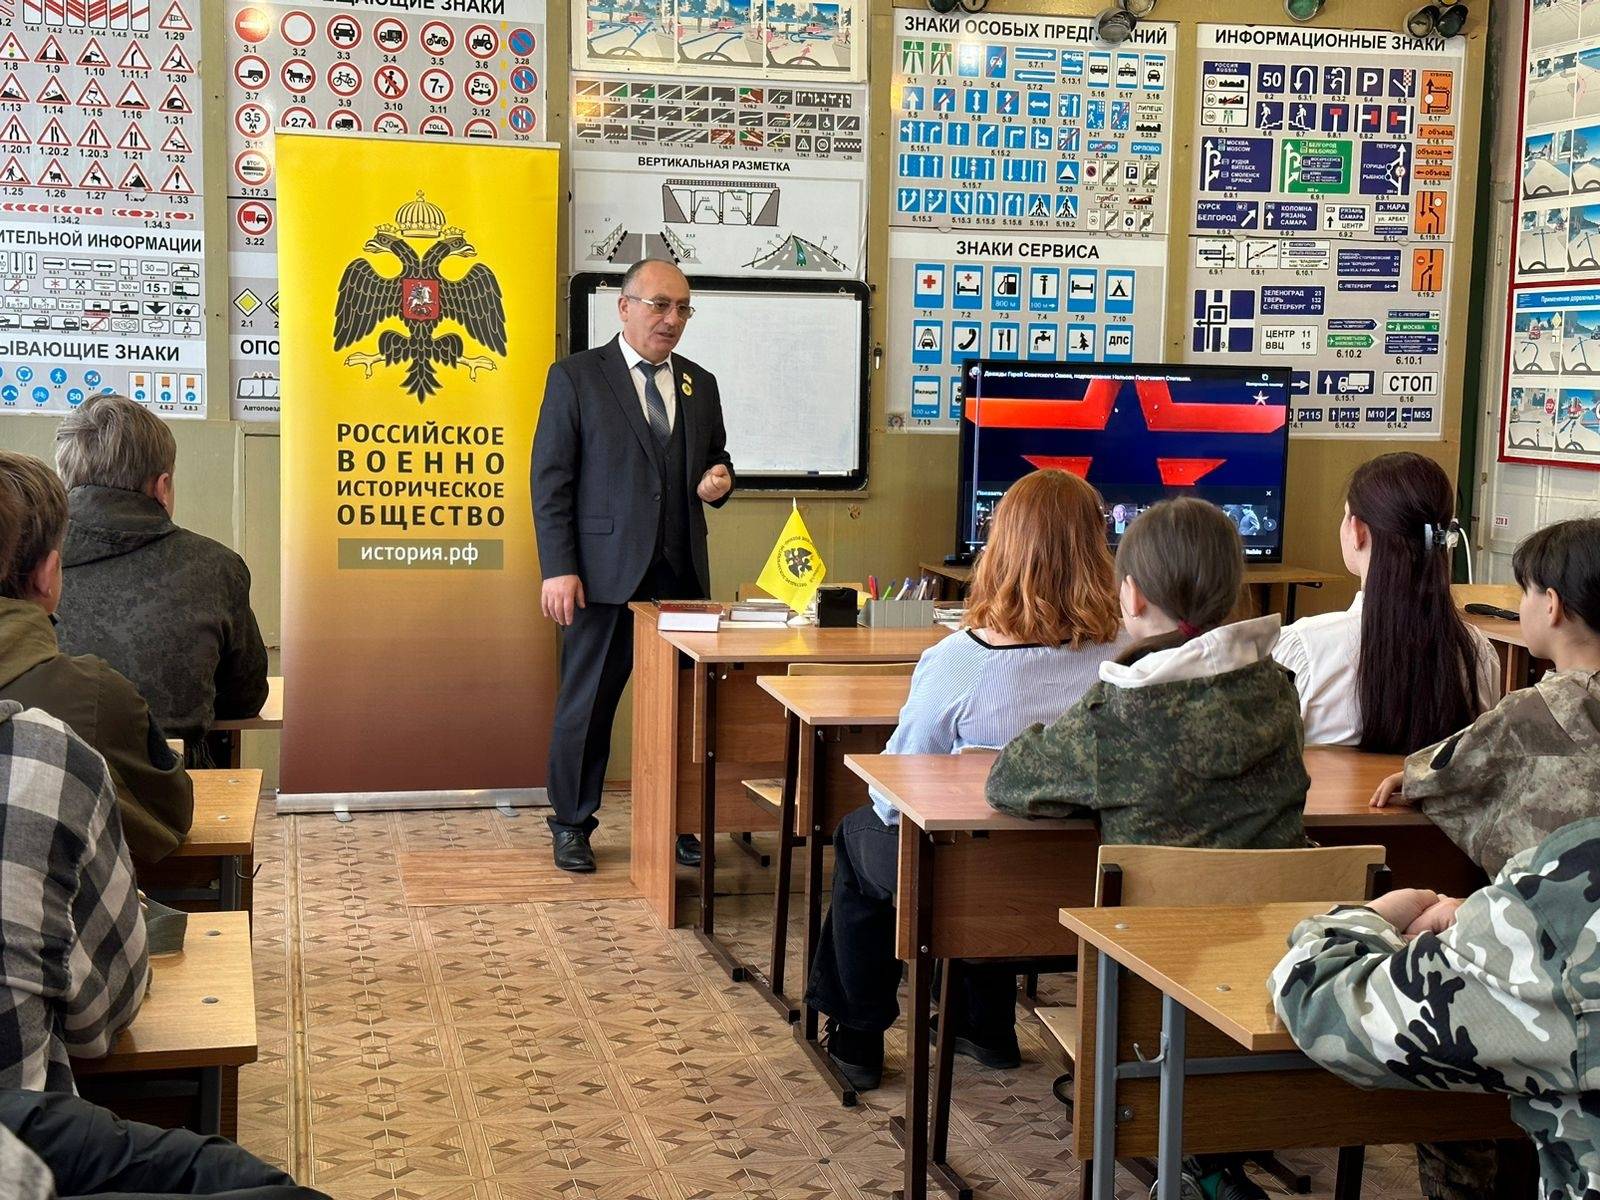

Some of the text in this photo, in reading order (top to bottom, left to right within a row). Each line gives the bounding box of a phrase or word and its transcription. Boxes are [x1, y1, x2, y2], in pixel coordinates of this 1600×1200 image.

[905, 16, 960, 33] ЗНАКИ
[965, 19, 1039, 38] ОСОБЫХ
[165, 32, 184, 40] 1.29
[1216, 30, 1445, 51] ИНФОРМАЦИОННЫЕ ЗНАКИ
[4, 62, 18, 70] 1.8
[46, 65, 60, 73] 1.9
[85, 68, 105, 76] 1.10
[121, 70, 148, 79] 1.11.1
[167, 74, 186, 83] 1.30
[1263, 72, 1282, 87] 50
[1363, 72, 1378, 92] P
[1, 103, 21, 112] 1.13
[43, 105, 63, 114] 1.14
[83, 108, 102, 116] 1.15
[472, 108, 490, 116] 3.12
[122, 110, 142, 119] 1.16
[245, 112, 260, 124] 3,5
[164, 116, 184, 125] 1.31
[2, 145, 31, 154] 1.20.1
[40, 147, 69, 156] 1.20.2
[80, 149, 108, 158] 1.20.3
[124, 151, 143, 160] 1.21
[166, 154, 185, 163] 1.32
[638, 156, 790, 172] ВЕРТИКАЛЬНАЯ РАЗМЕТКА
[3, 187, 23, 196] 1.25
[45, 189, 66, 198] 1.26
[242, 188, 269, 196] 3.17.3
[169, 196, 189, 204] 1.33
[53, 216, 80, 225] 1.34.2
[1198, 214, 1236, 222] БЕЛГОРОД
[144, 221, 171, 229] 1.34.3
[88, 234, 201, 253] ИНФОРМАЦИИ
[246, 238, 264, 246] 3.22
[957, 241, 1099, 259] ЗНАКИ СЕРВИСА
[147, 283, 160, 292] 15
[1266, 330, 1295, 338] ЦЕНТР
[1109, 336, 1129, 347] ДПС
[1266, 342, 1284, 350] ВВЦ
[115, 345, 179, 362] ЗНАКИ
[1337, 350, 1362, 358] 6.10.2
[1396, 356, 1422, 364] 6.10.1
[1390, 376, 1432, 392] СТОП
[1300, 411, 1320, 420] Р115
[338, 421, 504, 445] РОССИЙСКОЕ
[338, 450, 504, 474] ВОЕННО
[338, 480, 504, 498] ИСТОРИЧЕСКОЕ
[338, 504, 504, 530] ОБЩЕСТВО
[361, 543, 478, 564] история.рф
